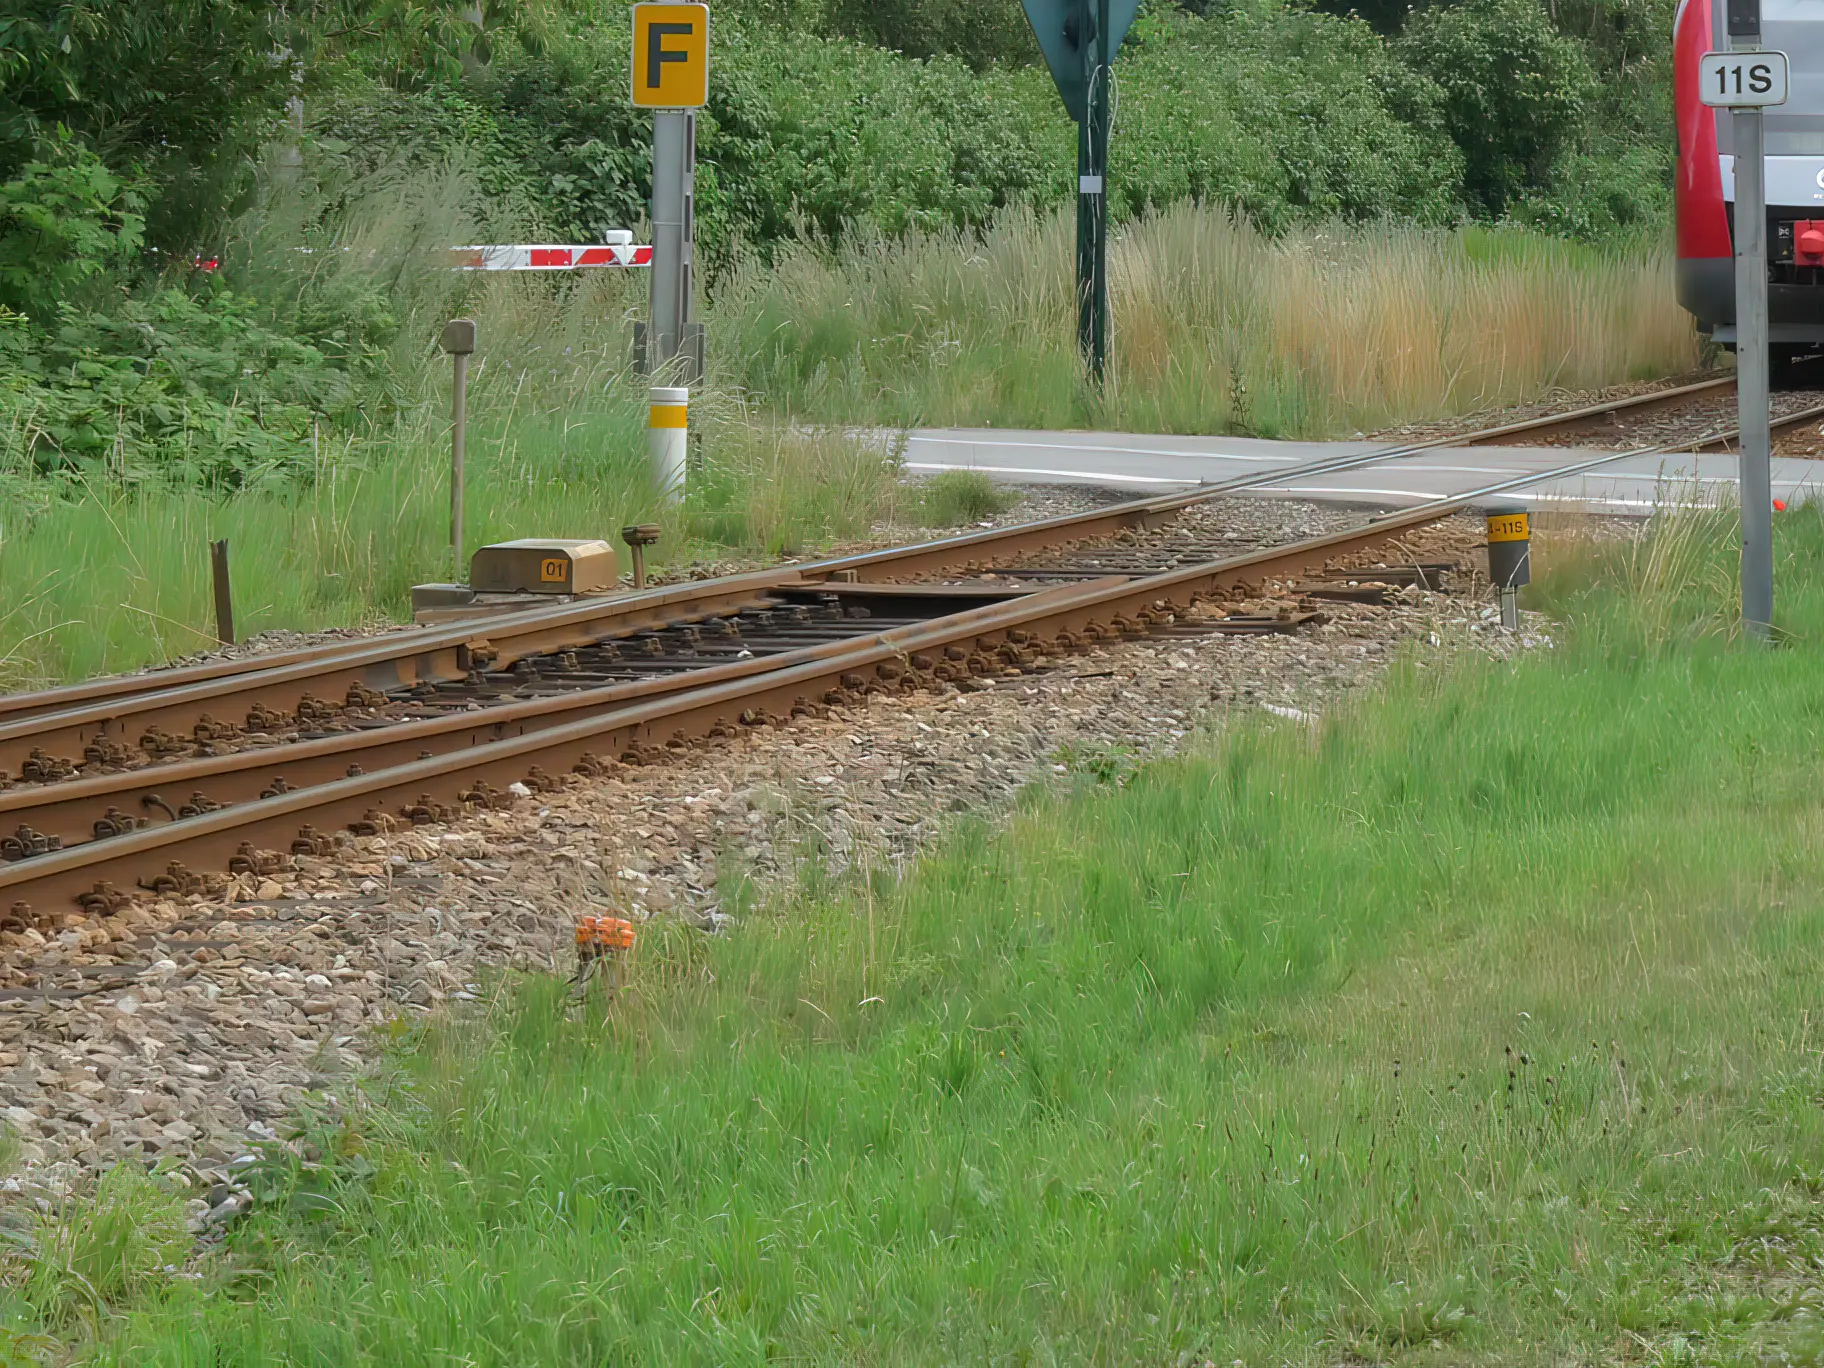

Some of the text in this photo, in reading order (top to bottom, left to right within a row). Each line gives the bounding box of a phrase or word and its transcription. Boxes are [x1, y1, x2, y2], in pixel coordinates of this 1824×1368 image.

[647, 23, 693, 89] F
[1715, 64, 1772, 94] 11S
[546, 561, 562, 577] 01
